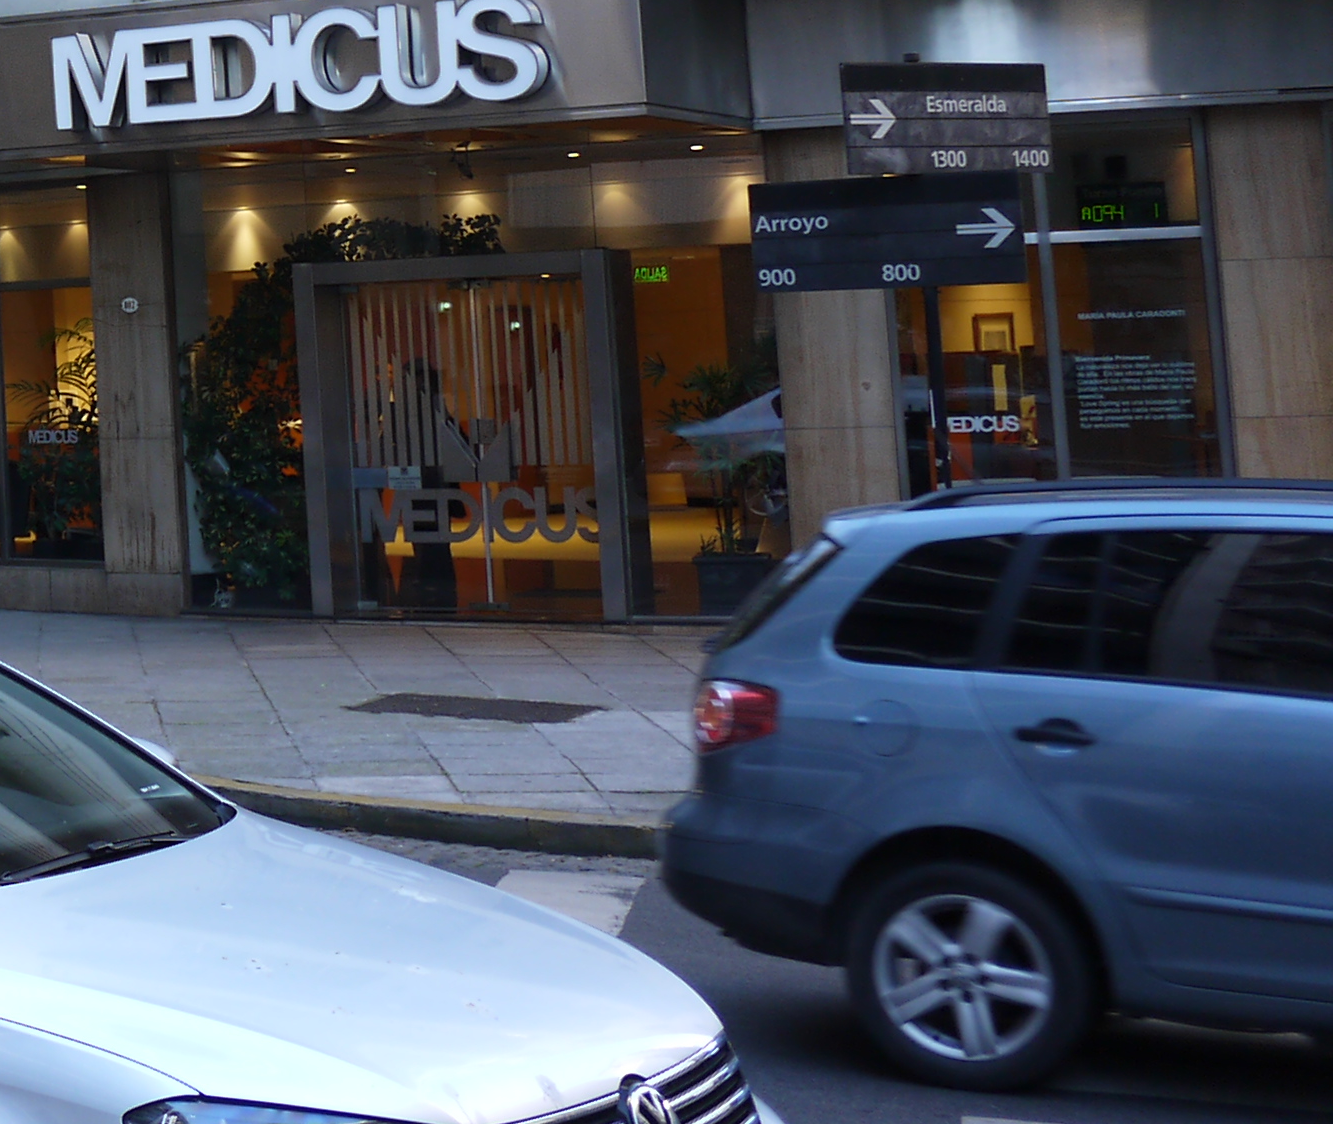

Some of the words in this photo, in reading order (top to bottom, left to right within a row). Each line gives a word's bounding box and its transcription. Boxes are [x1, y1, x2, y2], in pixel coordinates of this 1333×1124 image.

[926, 95, 1007, 113] Esmeralda
[931, 150, 967, 168] 1300
[1012, 149, 1050, 167] 1400
[1081, 205, 1124, 222] A094
[755, 215, 828, 235] Arroyo
[758, 268, 796, 286] 900
[882, 264, 921, 281] 800
[946, 415, 1021, 433] EDICUS
[28, 430, 79, 444] MEDICUS
